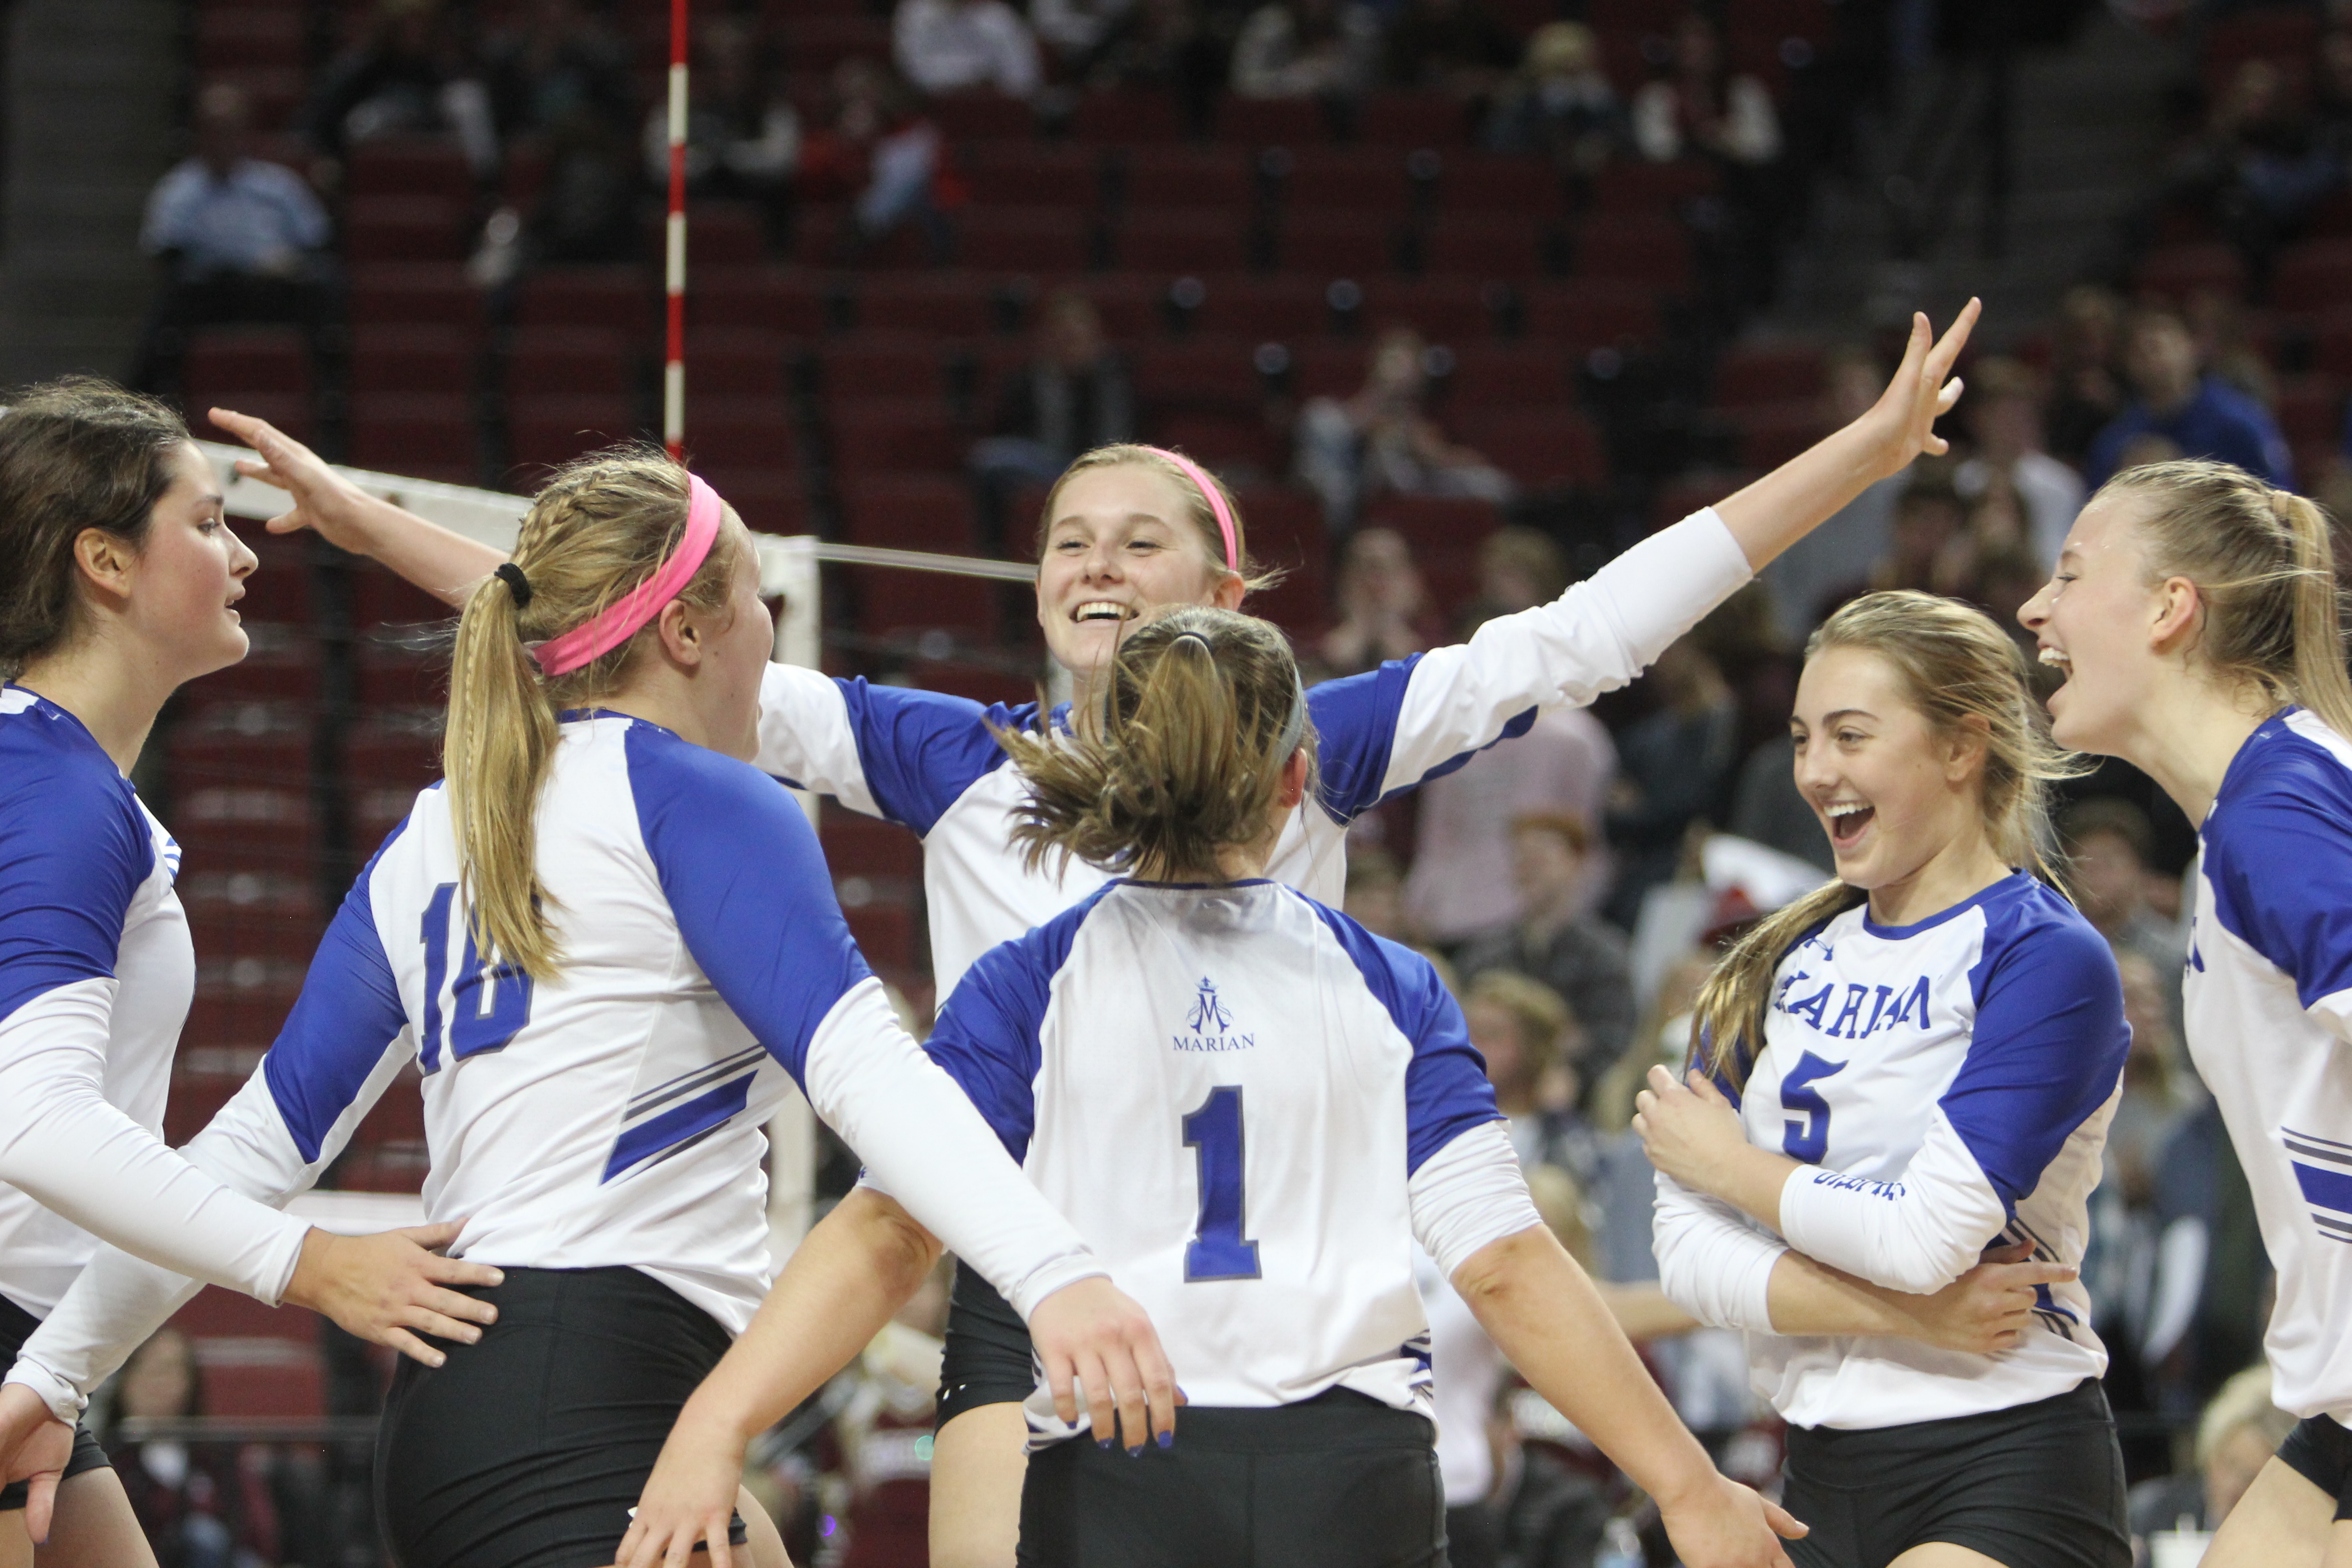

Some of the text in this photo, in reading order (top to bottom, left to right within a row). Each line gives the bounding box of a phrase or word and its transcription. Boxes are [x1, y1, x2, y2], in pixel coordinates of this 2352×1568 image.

[1173, 1032, 1255, 1051] MARIAN
[1779, 1049, 1849, 1165] 5
[1181, 1085, 1262, 1284] 1
